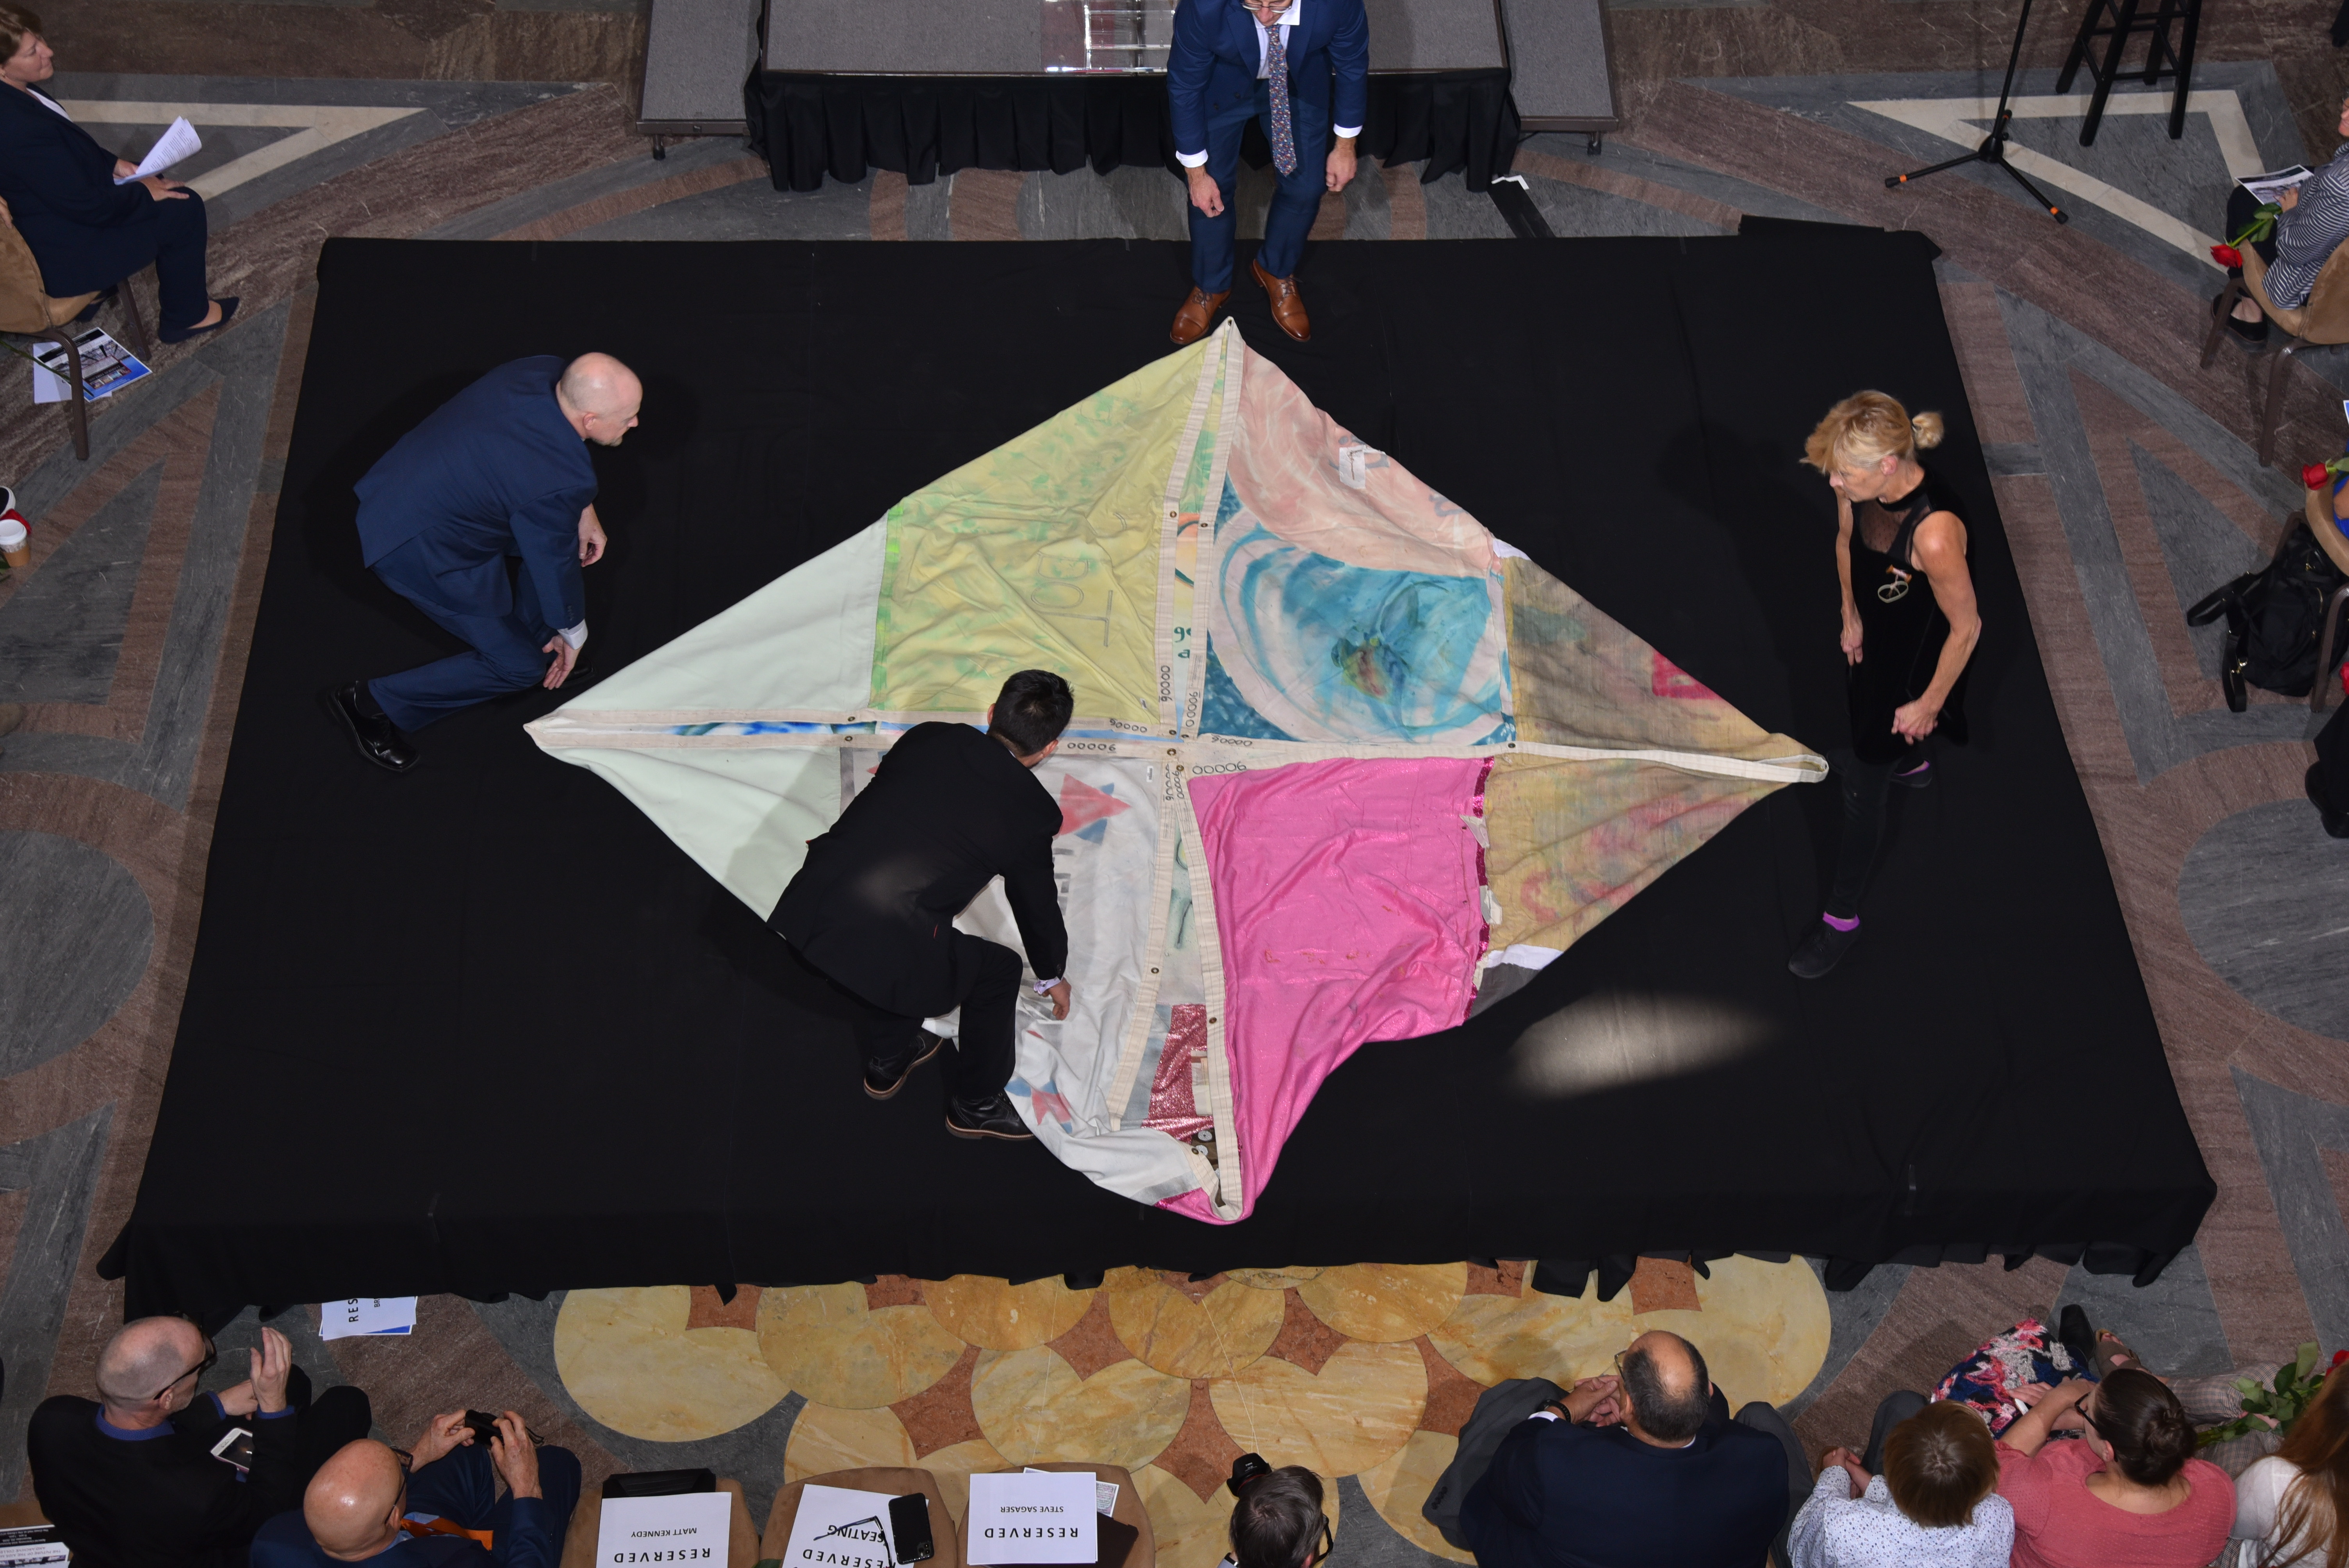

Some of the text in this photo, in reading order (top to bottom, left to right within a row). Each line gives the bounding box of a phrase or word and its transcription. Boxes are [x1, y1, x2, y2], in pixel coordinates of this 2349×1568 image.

[1067, 742, 1116, 753] 00006
[1192, 761, 1247, 774] 00006
[348, 1298, 358, 1322] RES
[827, 1525, 884, 1543] SEATING
[984, 1528, 1078, 1538] RESERVED
[614, 1548, 710, 1563] RESERVED
[802, 1549, 896, 1568] ESERVED
